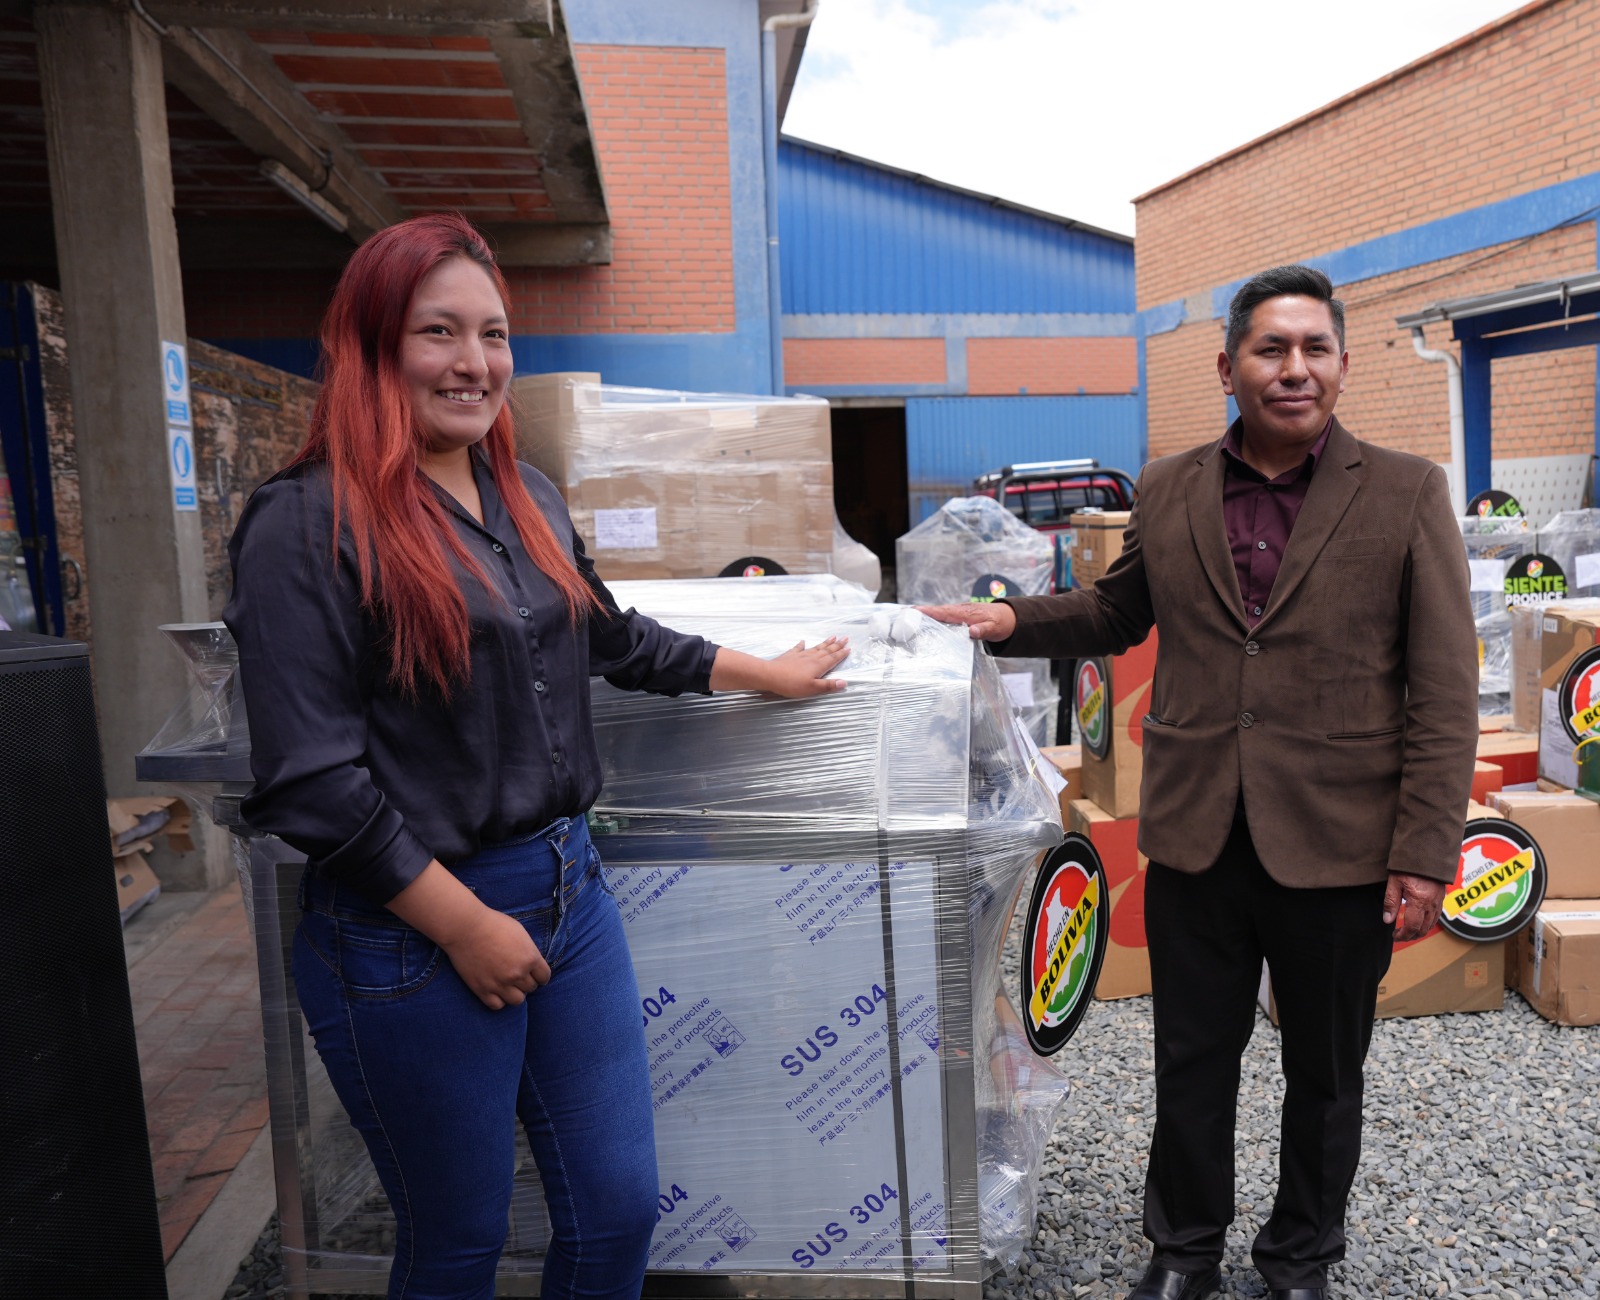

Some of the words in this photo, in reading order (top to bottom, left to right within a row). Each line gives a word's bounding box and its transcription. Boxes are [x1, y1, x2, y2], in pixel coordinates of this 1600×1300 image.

[628, 867, 662, 897] factory
[775, 878, 810, 908] Please
[786, 903, 807, 921] film
[806, 893, 818, 904] in
[817, 870, 844, 894] three
[797, 908, 826, 933] leave
[825, 894, 843, 909] the
[842, 863, 877, 893] factory
[1454, 859, 1525, 908] BOLIVIA
[1464, 866, 1485, 884] HECHO
[1485, 860, 1495, 873] EN
[1040, 896, 1093, 1005] BOLIVIA
[1047, 922, 1063, 958] HECHO
[1062, 909, 1070, 926] EN
[649, 1049, 674, 1073] onths
[674, 1038, 684, 1050] of
[684, 1008, 722, 1044] products
[652, 1033, 668, 1047] the
[668, 997, 710, 1036] protective
[780, 1025, 839, 1077] SUS
[840, 983, 888, 1028] 304
[651, 1070, 674, 1093] ctory
[785, 1082, 819, 1110] Please
[819, 1065, 839, 1083] tear
[839, 1044, 864, 1067] down
[863, 1031, 880, 1046] the
[796, 1105, 816, 1122] film
[816, 1096, 827, 1107] in
[827, 1075, 852, 1097] three
[853, 1047, 887, 1076] months
[897, 1004, 936, 1041] products
[807, 1111, 835, 1134] leave
[835, 1097, 852, 1111] the
[851, 1068, 885, 1097] factory
[648, 1240, 666, 1258] own
[665, 1228, 681, 1242] the
[681, 1194, 722, 1231] protective
[656, 1183, 688, 1222] 04
[791, 1222, 848, 1269] SUS
[850, 1182, 898, 1225] 304
[656, 1243, 687, 1270] months
[687, 1233, 697, 1244] of
[696, 1205, 734, 1238] products
[849, 1240, 874, 1261] down
[862, 1242, 895, 1270] months
[910, 1202, 944, 1233] roducts
